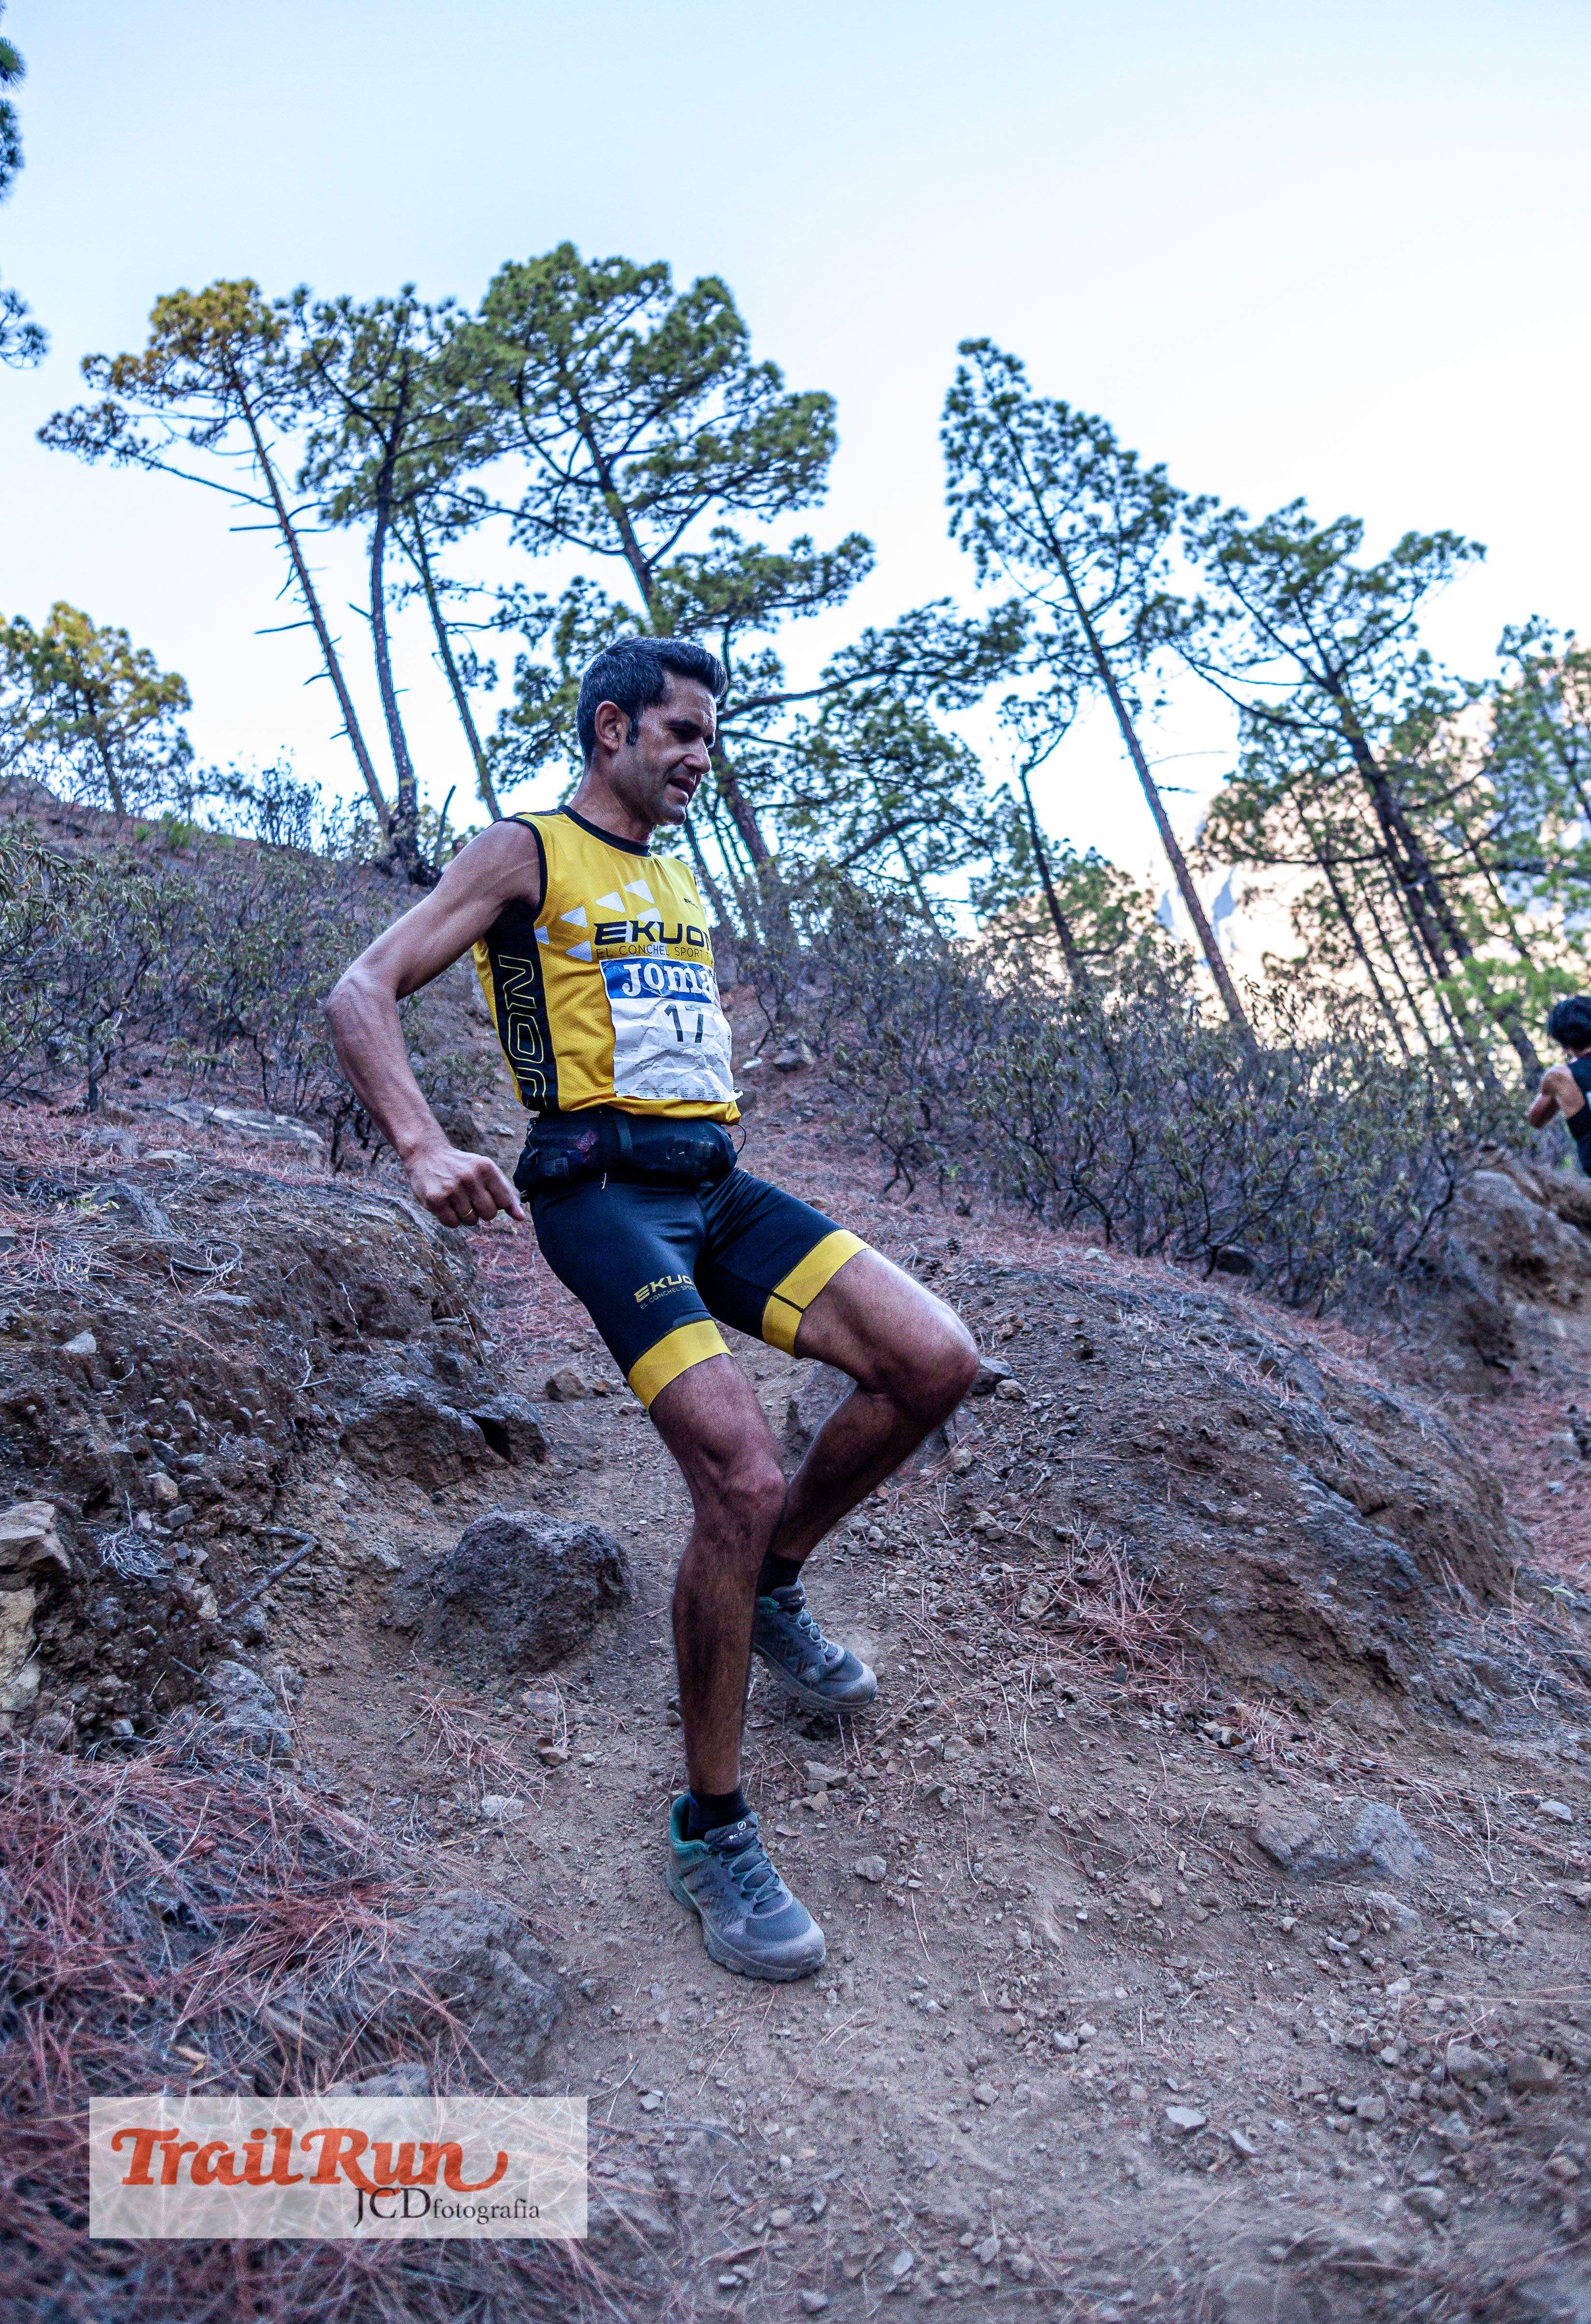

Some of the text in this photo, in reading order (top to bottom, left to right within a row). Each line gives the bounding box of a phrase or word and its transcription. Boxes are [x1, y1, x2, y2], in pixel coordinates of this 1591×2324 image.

[596, 948, 614, 959] EL
[619, 944, 670, 956] CONCHEL
[674, 946, 703, 959] SPORT
[664, 1003, 704, 1043] 17
[633, 1274, 693, 1303] EKUO
[648, 1287, 680, 1303] CONCHEL
